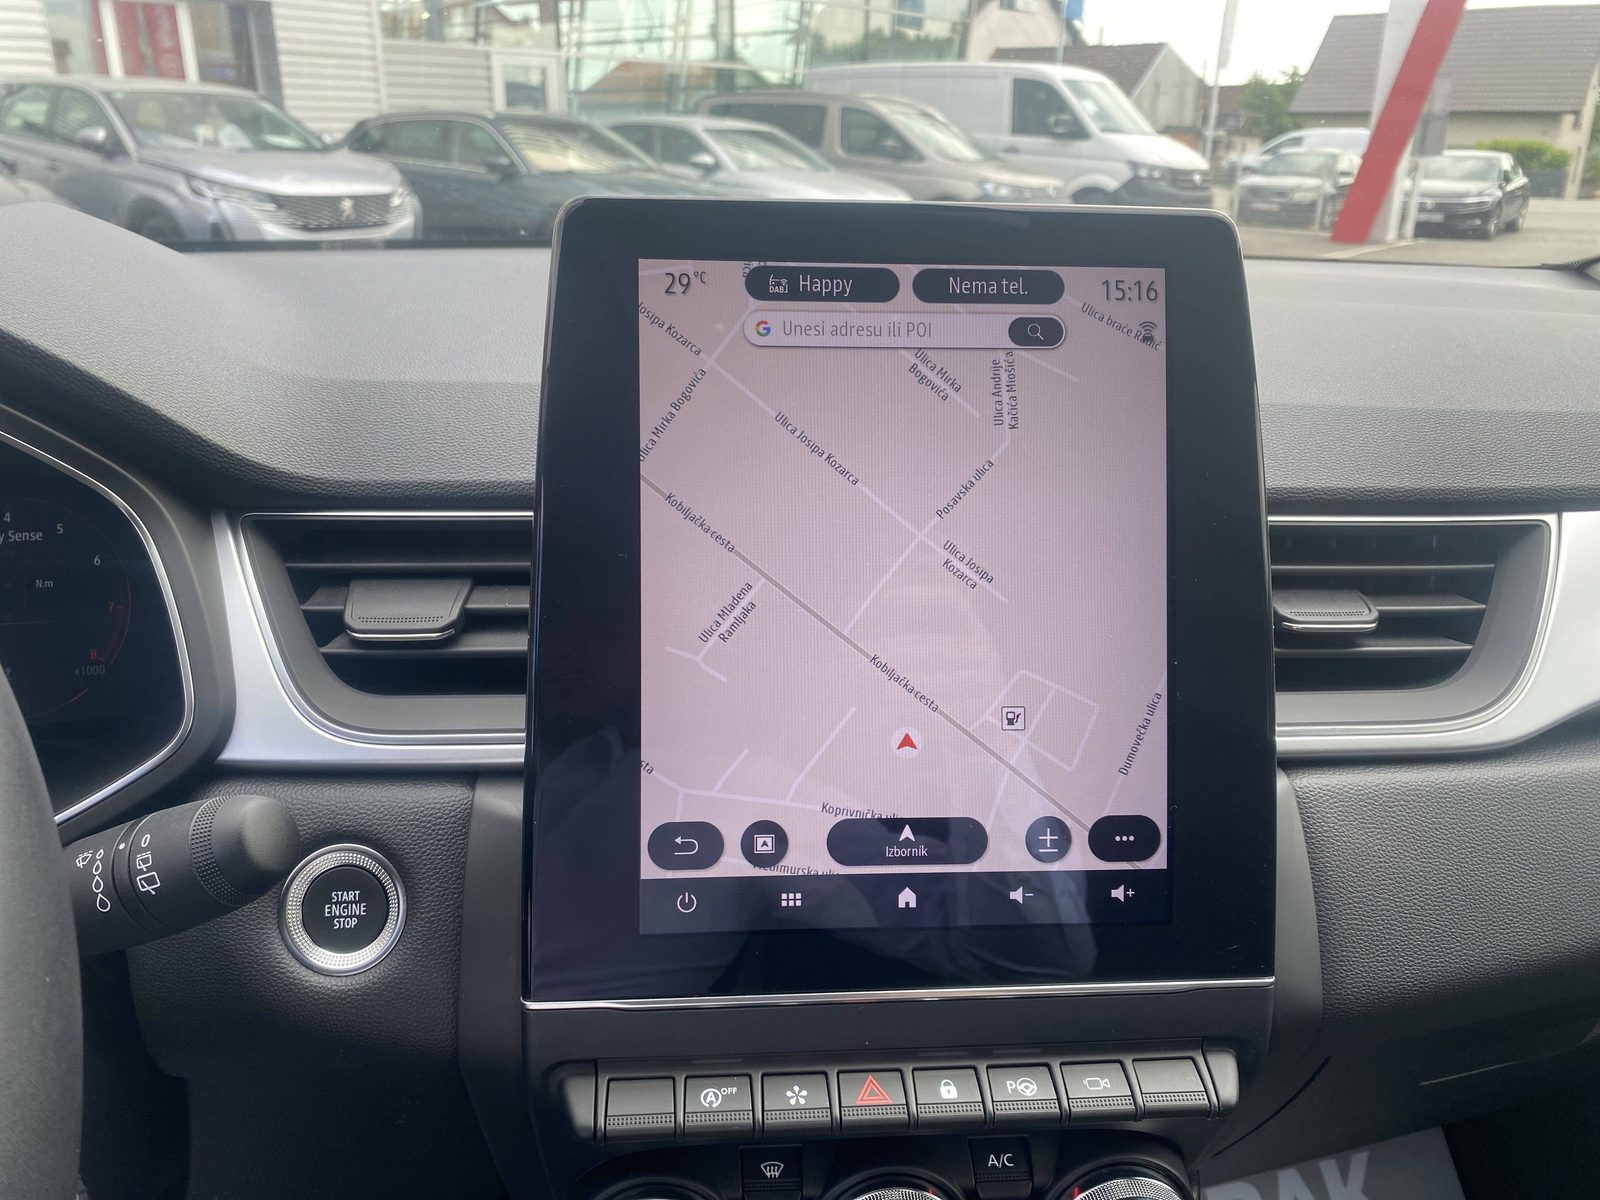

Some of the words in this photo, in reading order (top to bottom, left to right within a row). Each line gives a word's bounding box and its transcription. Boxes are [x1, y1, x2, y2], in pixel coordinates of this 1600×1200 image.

[799, 274, 853, 296] Happy
[949, 276, 997, 295] Nema
[1001, 277, 1028, 296] tel.
[1101, 279, 1158, 301] 15:16
[782, 319, 825, 338] Unesi
[829, 318, 882, 339] adresu
[886, 319, 902, 339] ili
[906, 321, 932, 339] POI
[1081, 301, 1105, 322] Ulica
[1105, 313, 1133, 337] braće
[665, 323, 702, 356] Kozarca
[908, 362, 949, 401] Bogovića
[914, 348, 937, 372] Ulica
[936, 367, 962, 393] Mirka
[990, 359, 1003, 397] Andrije
[651, 411, 676, 439] Mirka
[669, 368, 707, 412] Bogovića
[993, 400, 1004, 426] Ulica
[1007, 395, 1019, 430] Kačića
[774, 410, 797, 435] Ulica
[796, 430, 825, 458] Josipa
[824, 452, 859, 486] Kozarca
[935, 479, 976, 519] Posavska
[973, 459, 994, 482] ulica
[3, 511, 11, 523] 4
[56, 523, 64, 535] 5
[665, 492, 711, 534] Kobiljačka
[710, 529, 736, 553] cesta
[8, 530, 43, 542] Sense
[93, 554, 101, 566] 6
[942, 539, 966, 562] Ulica
[965, 556, 994, 584] Josipa
[35, 579, 54, 589] N.m
[941, 558, 977, 590] Kozarca
[698, 618, 722, 644] Ulica
[716, 581, 753, 620] Mladena
[717, 600, 757, 644] Ramljaka
[89, 649, 97, 660] 8
[870, 654, 915, 694] Kobiljačka
[914, 690, 939, 713] cesta
[1117, 717, 1151, 776] Dumovečka
[1145, 692, 1163, 717] ulica
[885, 845, 928, 859] Izbornik
[324, 902, 367, 917] ENGINE
[331, 890, 361, 903] START
[333, 917, 358, 929] STOP
[720, 1086, 738, 1096] OFF
[987, 1151, 1015, 1169] A/C
